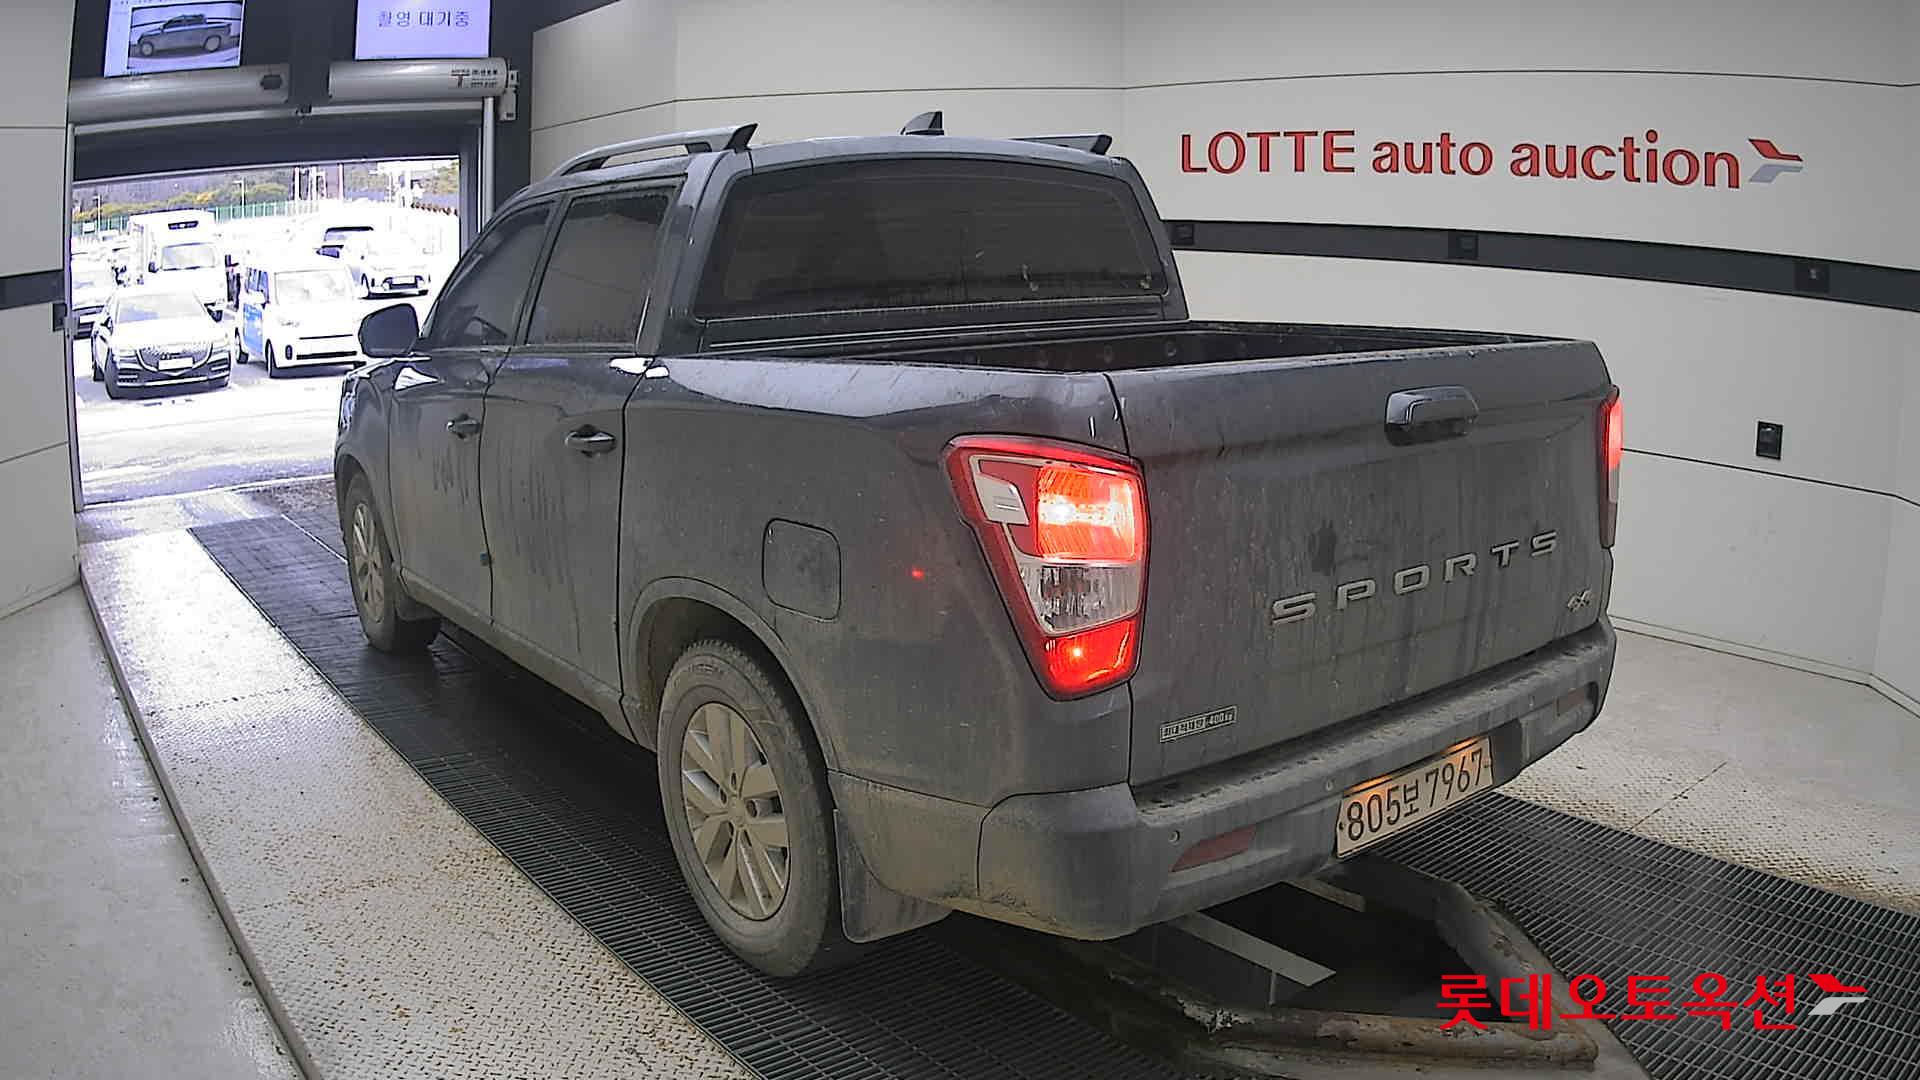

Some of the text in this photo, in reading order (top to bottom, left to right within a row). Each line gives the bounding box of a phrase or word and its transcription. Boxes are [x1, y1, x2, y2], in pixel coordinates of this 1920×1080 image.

[1181, 129, 1741, 189] LOTTE auto auction
[1271, 530, 1558, 626] SPORTS
